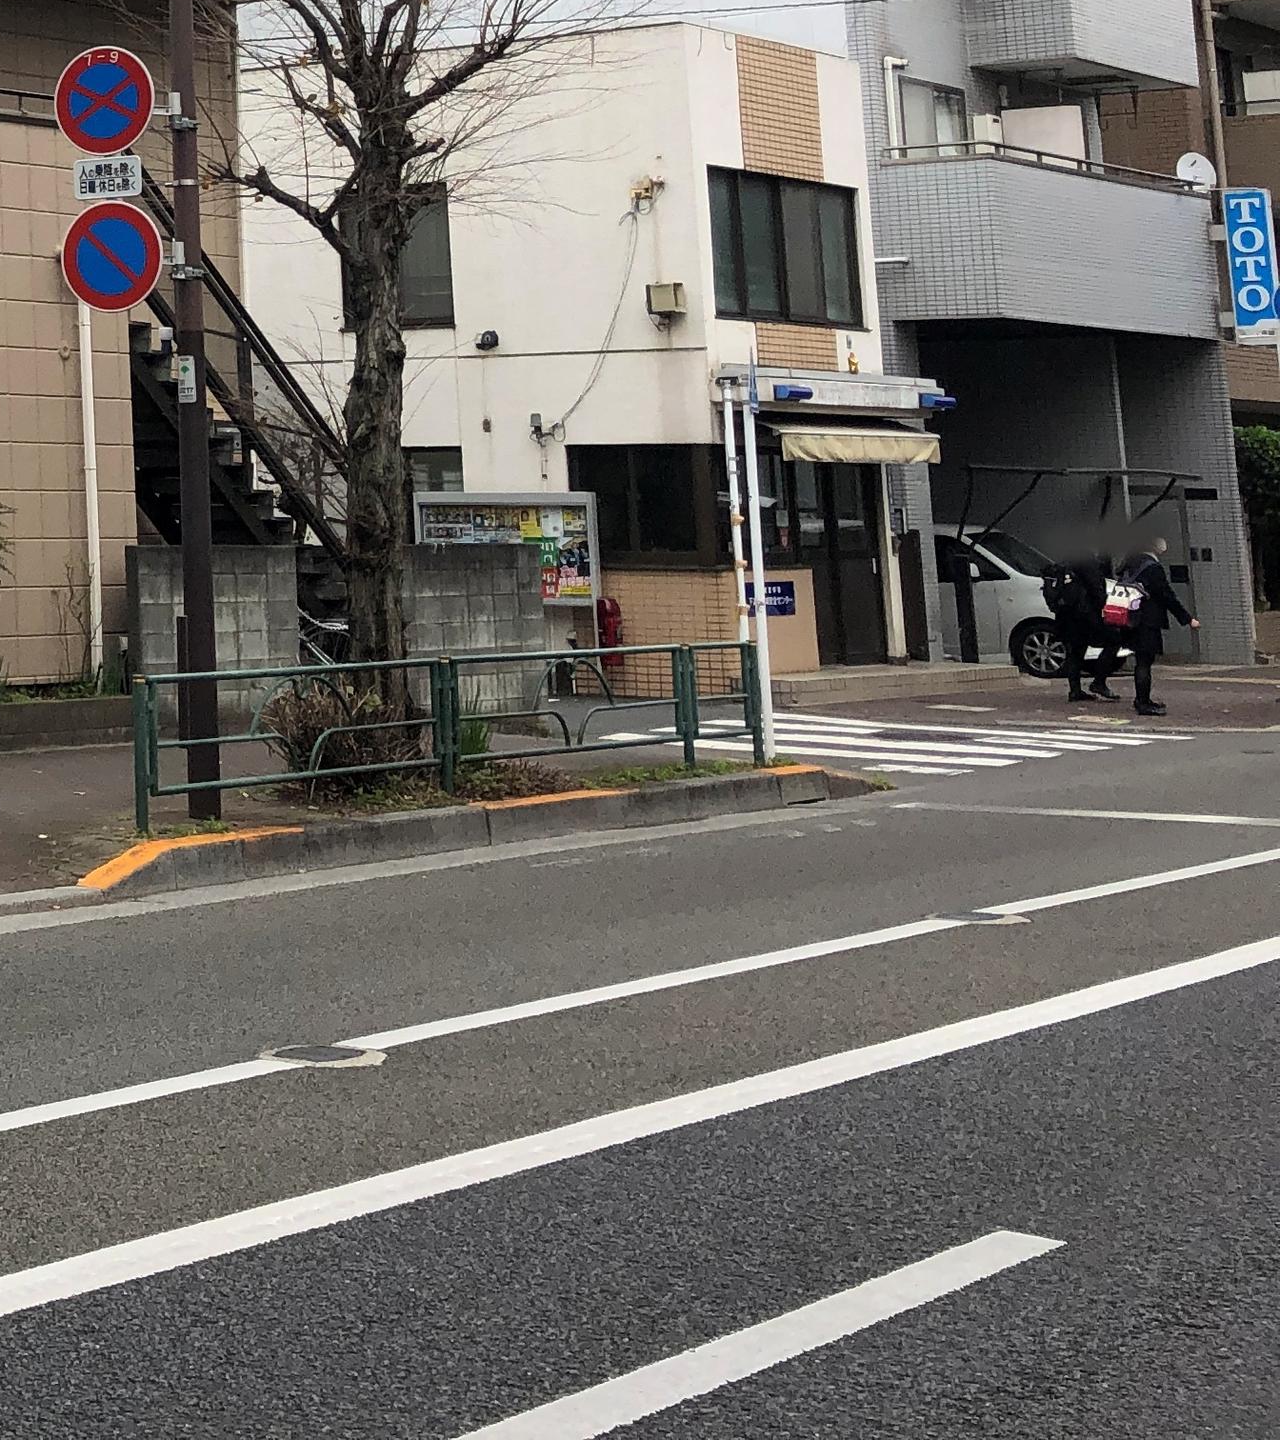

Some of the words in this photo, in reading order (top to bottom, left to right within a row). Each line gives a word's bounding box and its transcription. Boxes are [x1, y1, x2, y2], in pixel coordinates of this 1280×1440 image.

[79, 162, 136, 179] 人の乗降を除く
[1229, 198, 1271, 312] TOTO
